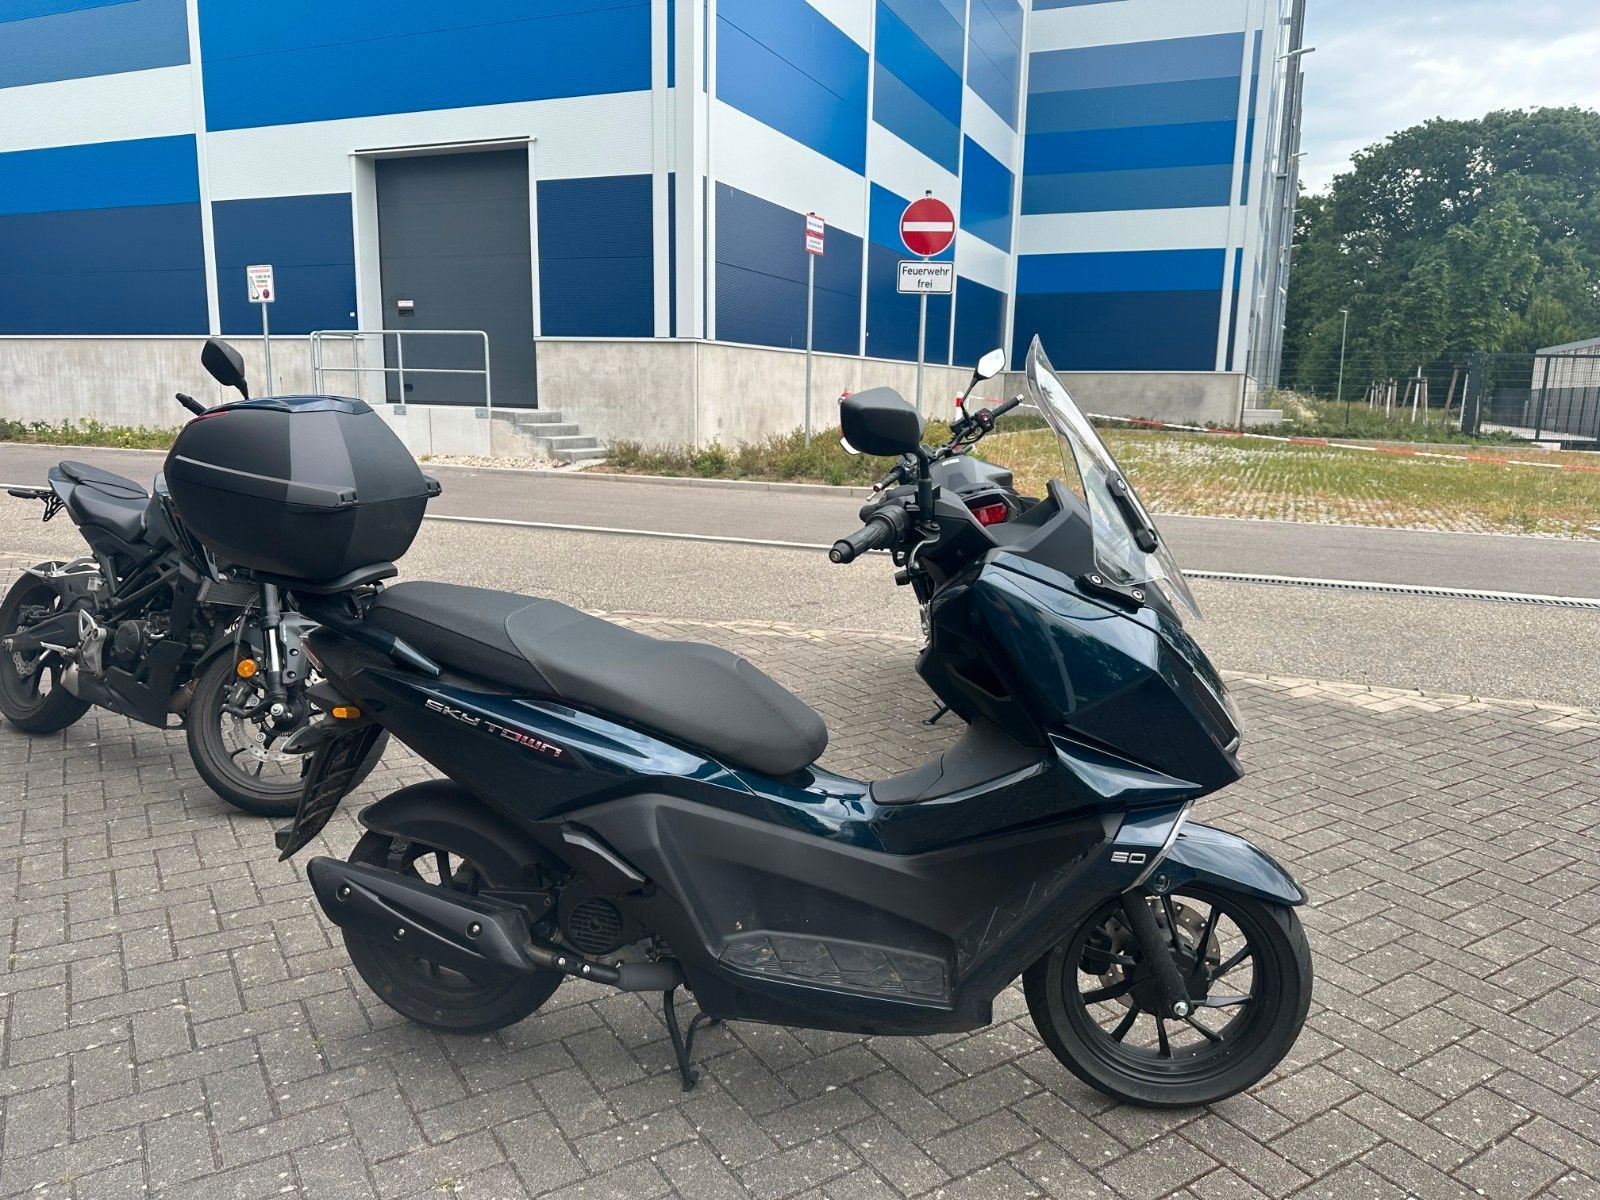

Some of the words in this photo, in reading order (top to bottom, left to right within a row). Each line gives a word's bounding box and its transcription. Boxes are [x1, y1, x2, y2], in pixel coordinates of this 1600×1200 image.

[902, 266, 950, 276] Feuerwehr
[917, 279, 933, 288] frei
[425, 698, 481, 726] SKY
[1110, 851, 1147, 865] 50
